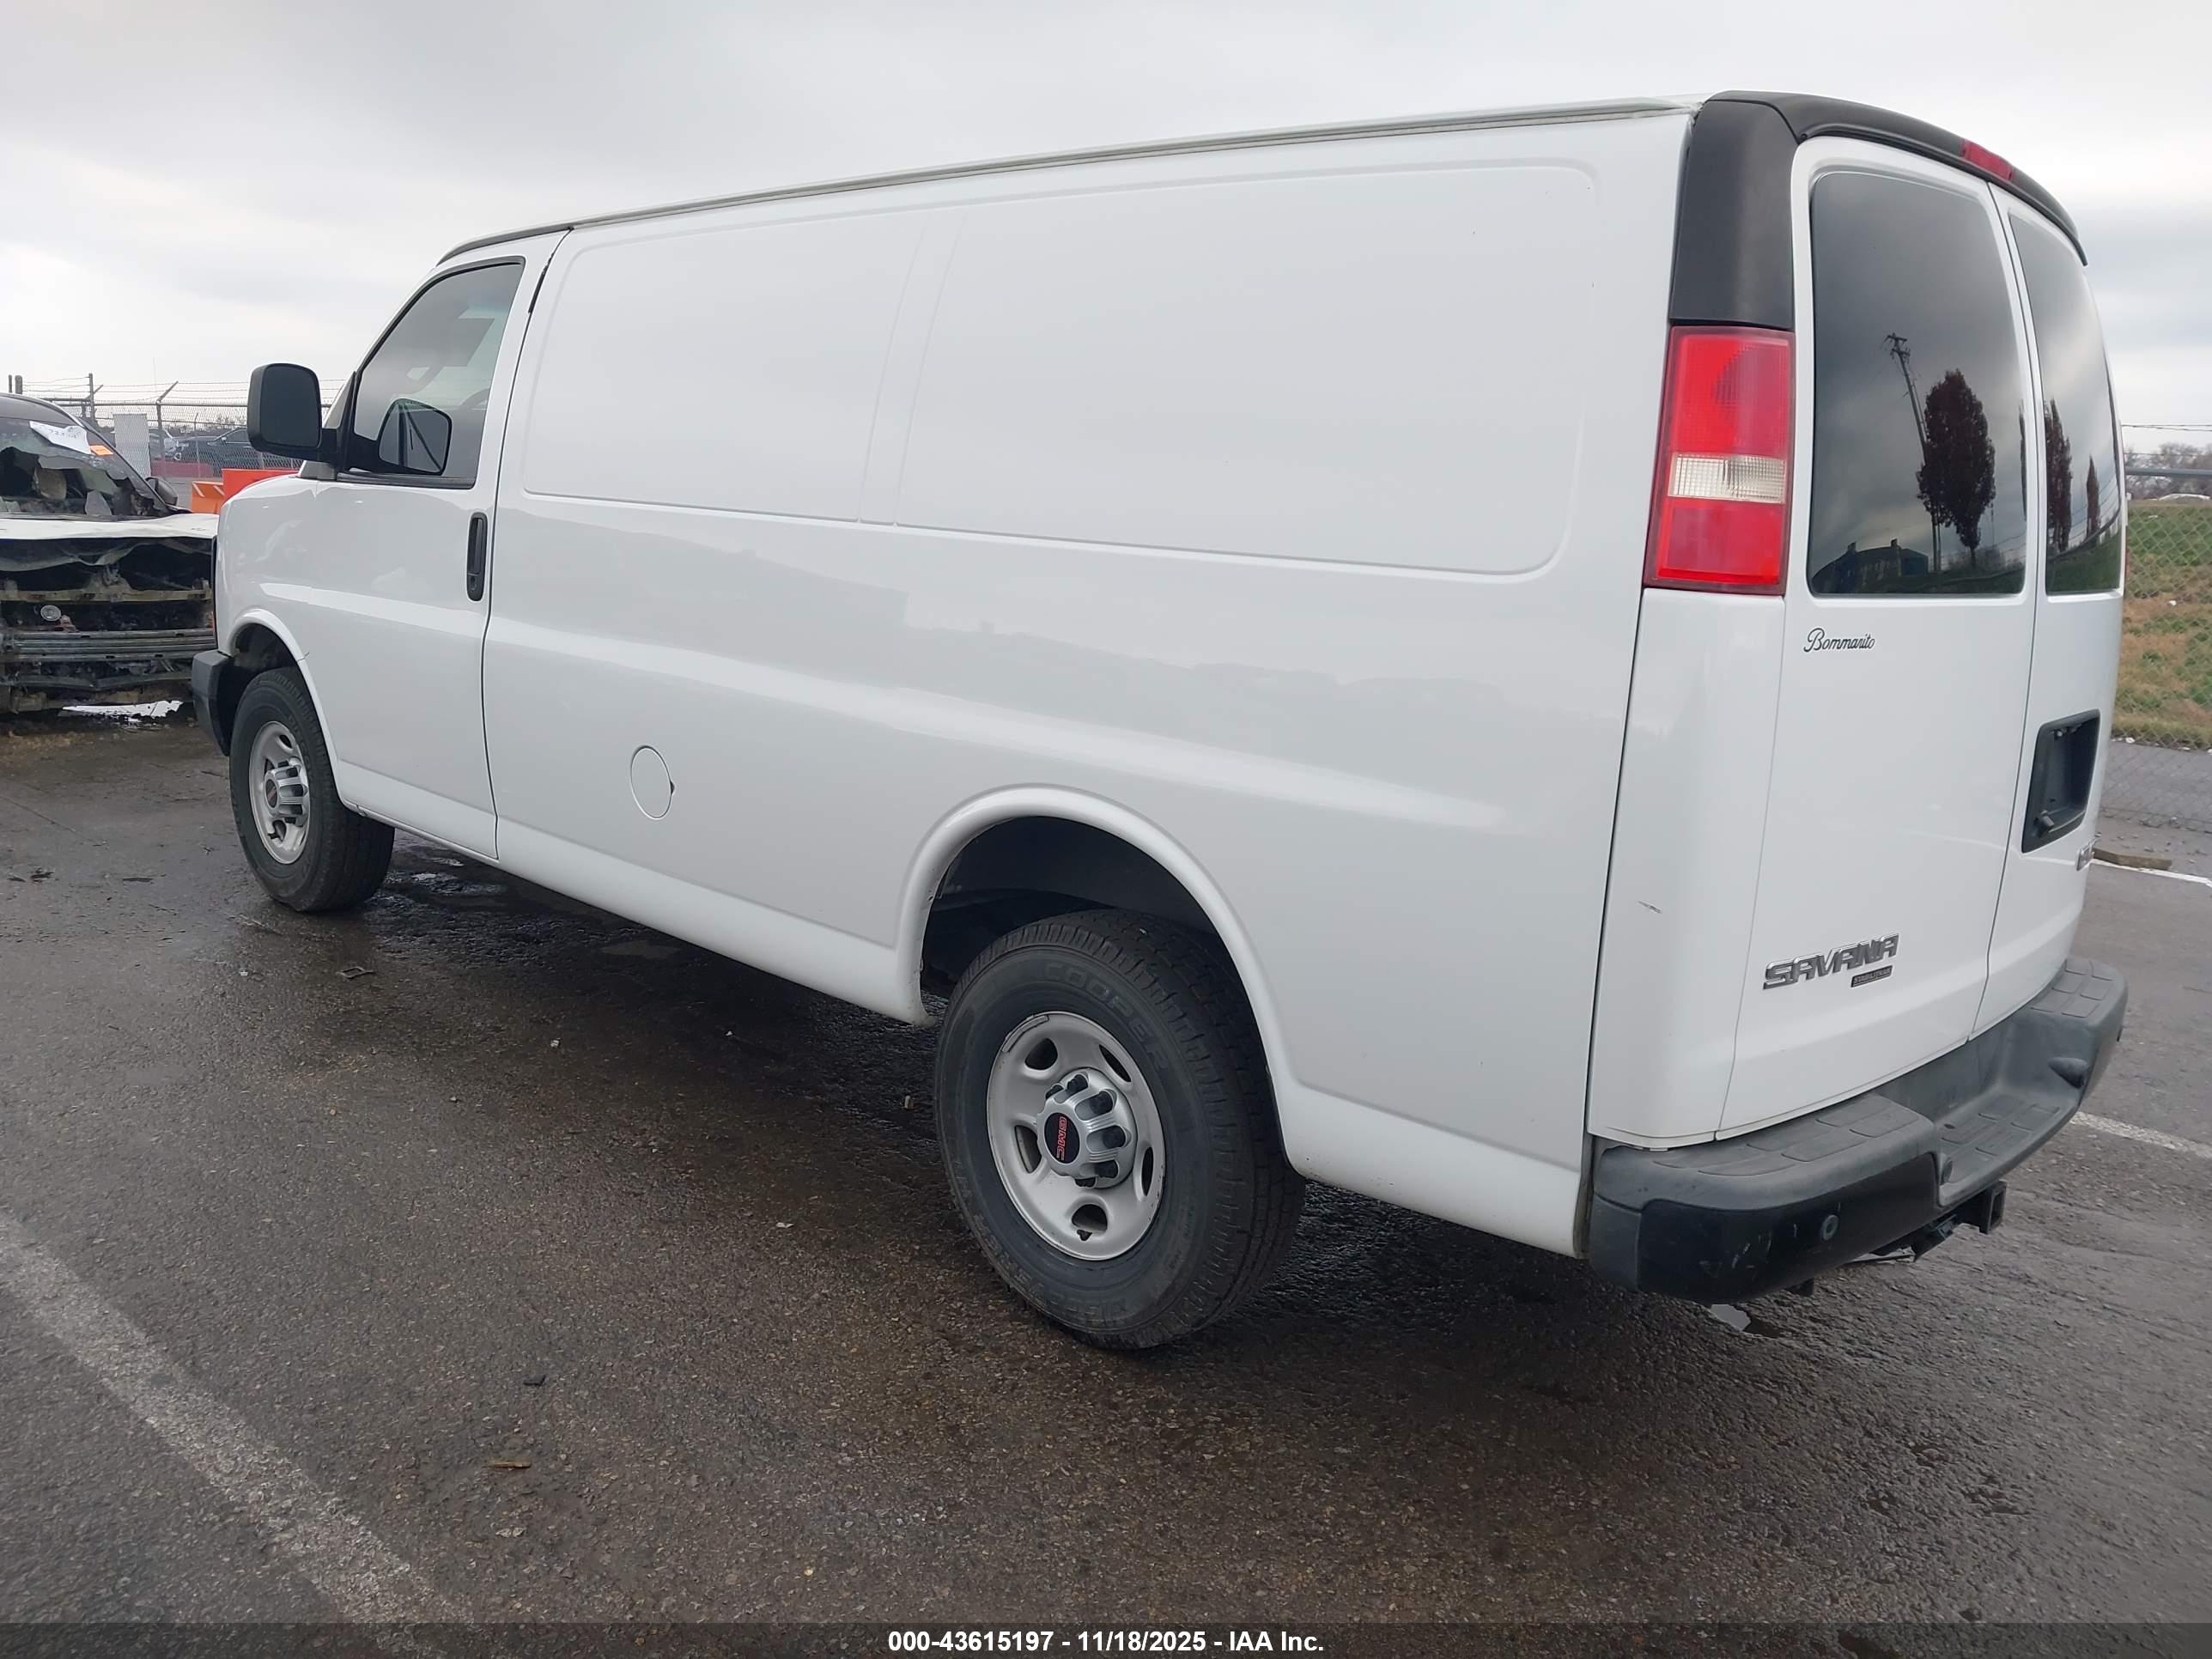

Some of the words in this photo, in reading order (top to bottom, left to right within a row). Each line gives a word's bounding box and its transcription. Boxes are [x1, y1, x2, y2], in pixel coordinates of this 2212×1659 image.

[1803, 627, 1875, 653] Bommarito
[1763, 933, 1899, 989] SAVANA
[1056, 1116, 1067, 1161] GMC
